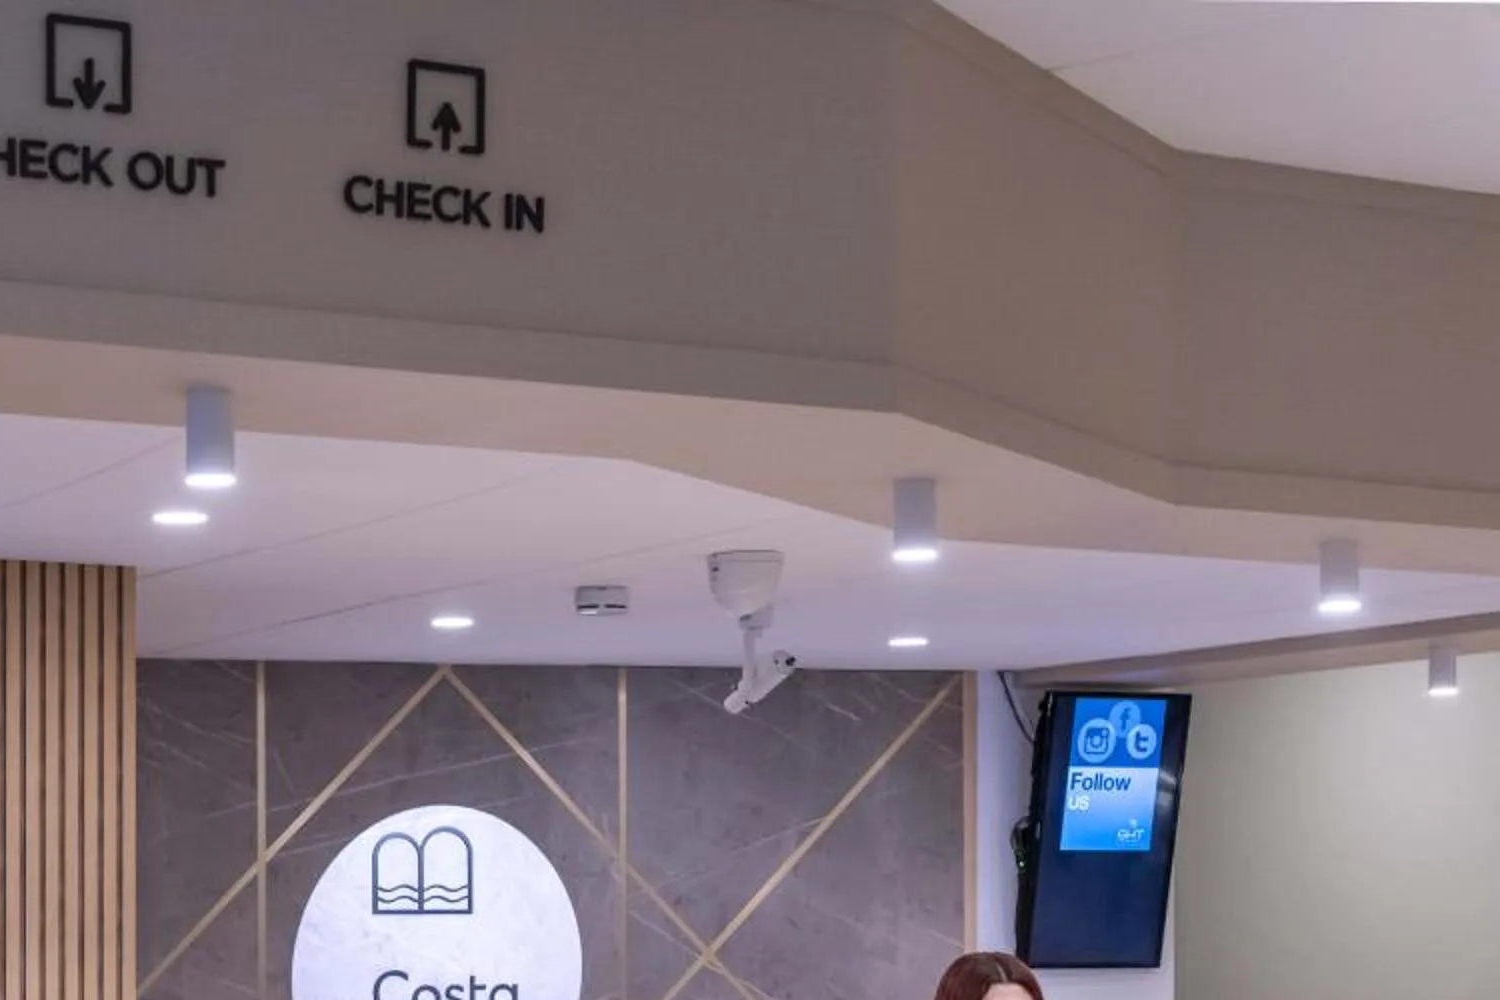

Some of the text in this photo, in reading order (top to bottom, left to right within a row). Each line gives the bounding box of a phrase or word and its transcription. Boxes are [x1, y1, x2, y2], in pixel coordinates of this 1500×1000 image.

[127, 151, 226, 198] OUT
[343, 174, 545, 233] CHECK IN
[1069, 771, 1132, 791] Follow
